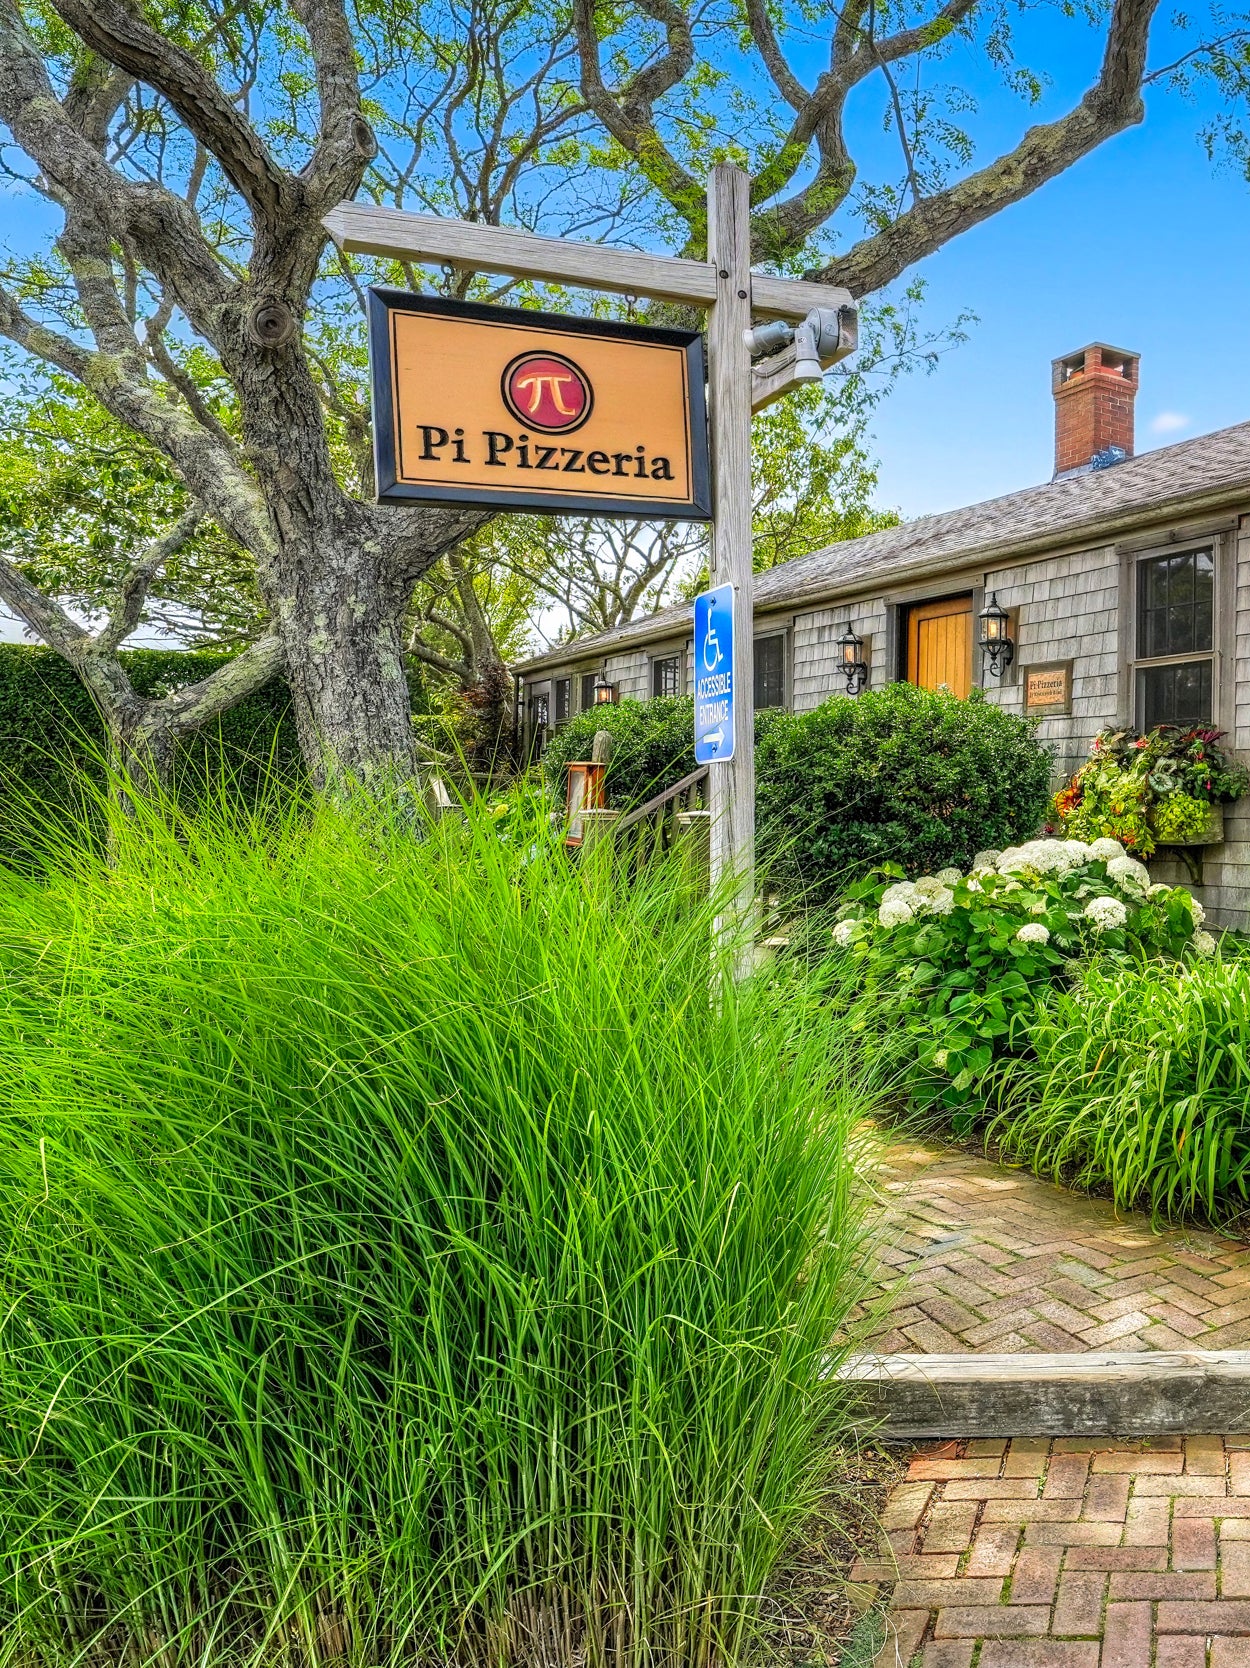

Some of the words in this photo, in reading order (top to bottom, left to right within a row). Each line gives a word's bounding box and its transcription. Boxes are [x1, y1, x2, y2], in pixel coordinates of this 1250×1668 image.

[416, 425, 471, 463] Pi
[482, 431, 675, 480] Pizzeria
[697, 672, 731, 699] ACCESSIBLE
[1030, 680, 1037, 690] Pi
[1037, 678, 1062, 689] Pizzeria
[700, 700, 728, 725] ENTRANCE
